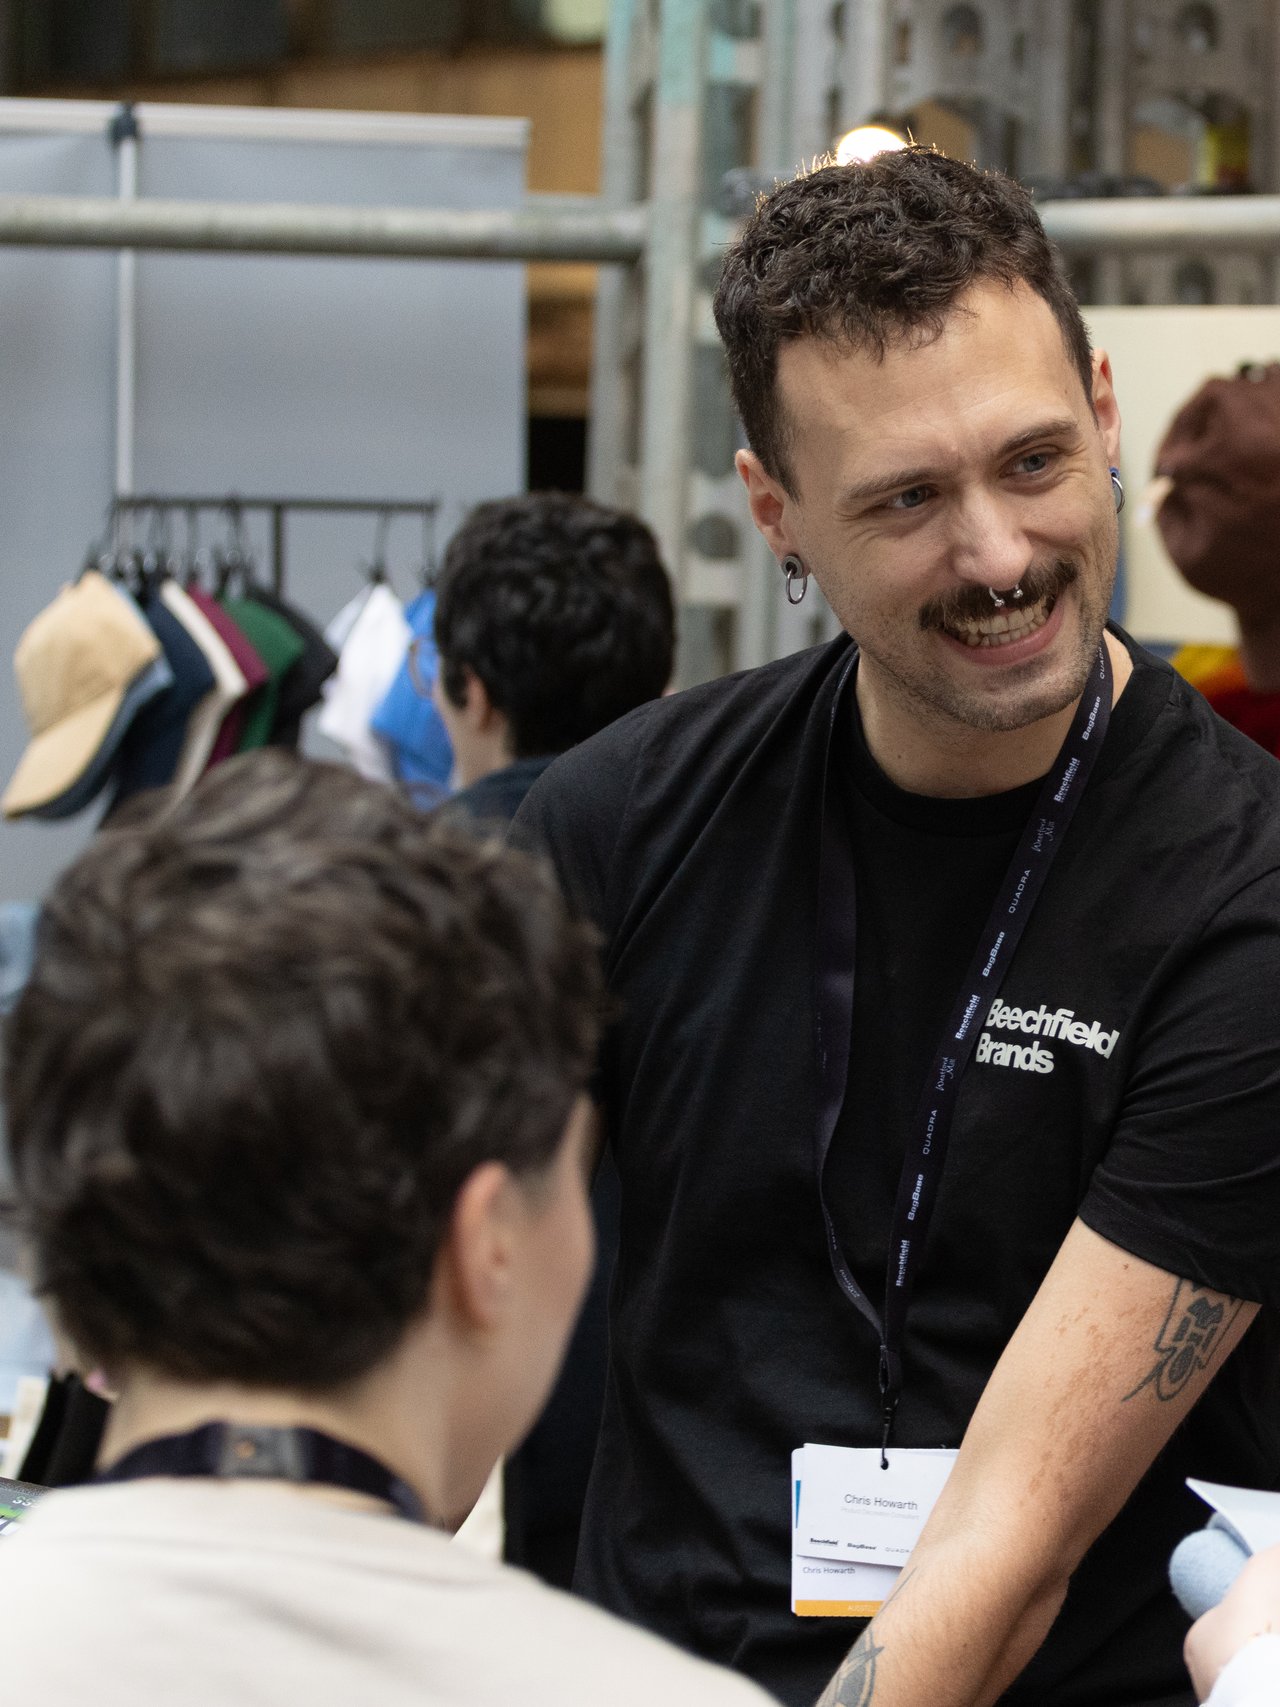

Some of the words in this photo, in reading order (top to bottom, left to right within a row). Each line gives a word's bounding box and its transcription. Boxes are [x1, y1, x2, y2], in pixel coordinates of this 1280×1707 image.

[1081, 696, 1101, 741] BagBase
[1054, 757, 1079, 803] Beechfield
[1008, 869, 1031, 914] QUADRA
[982, 931, 1005, 977] BagBase
[955, 994, 980, 1040] Beechfield
[985, 998, 1120, 1060] Beechfield
[975, 1032, 1054, 1074] Brands
[923, 1109, 938, 1155] QUADRA
[907, 1173, 924, 1221] BagBase
[844, 1493, 871, 1506] Chris
[874, 1496, 918, 1510] Howarth
[803, 1566, 822, 1575] Chris
[823, 1566, 856, 1575] Howarth
